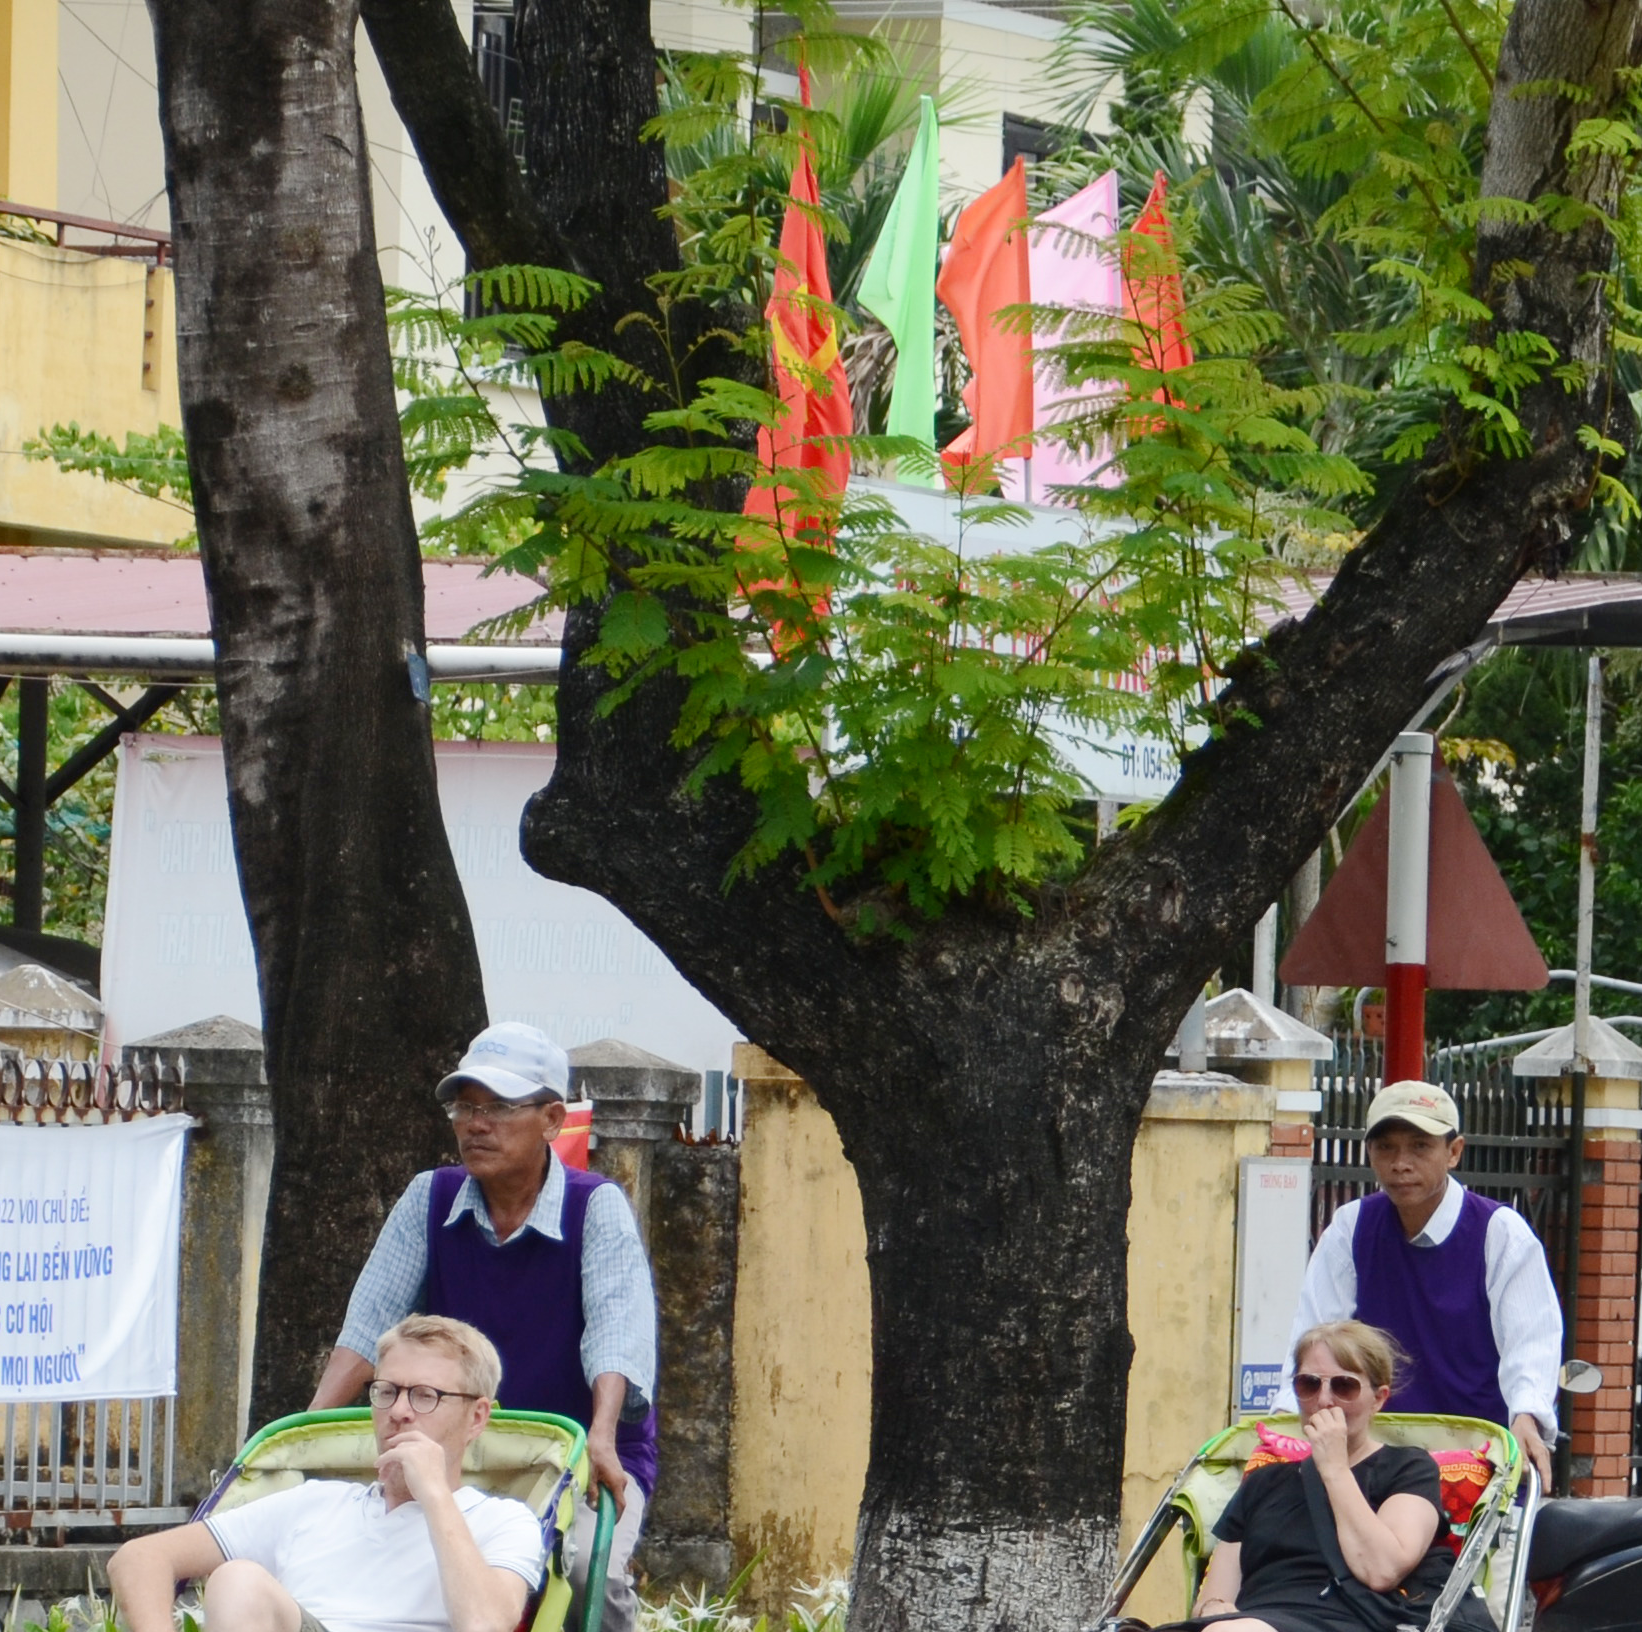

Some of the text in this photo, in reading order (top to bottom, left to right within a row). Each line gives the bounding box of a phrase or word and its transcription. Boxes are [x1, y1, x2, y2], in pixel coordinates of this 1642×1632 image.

[208, 821, 236, 874] HU
[42, 1189, 67, 1224] CHỦ
[16, 1252, 37, 1281] LAI
[74, 1243, 113, 1280] VỮNG
[6, 1301, 25, 1334] CƠ
[29, 1297, 53, 1340] HỘI
[1, 1356, 28, 1393] MỌI
